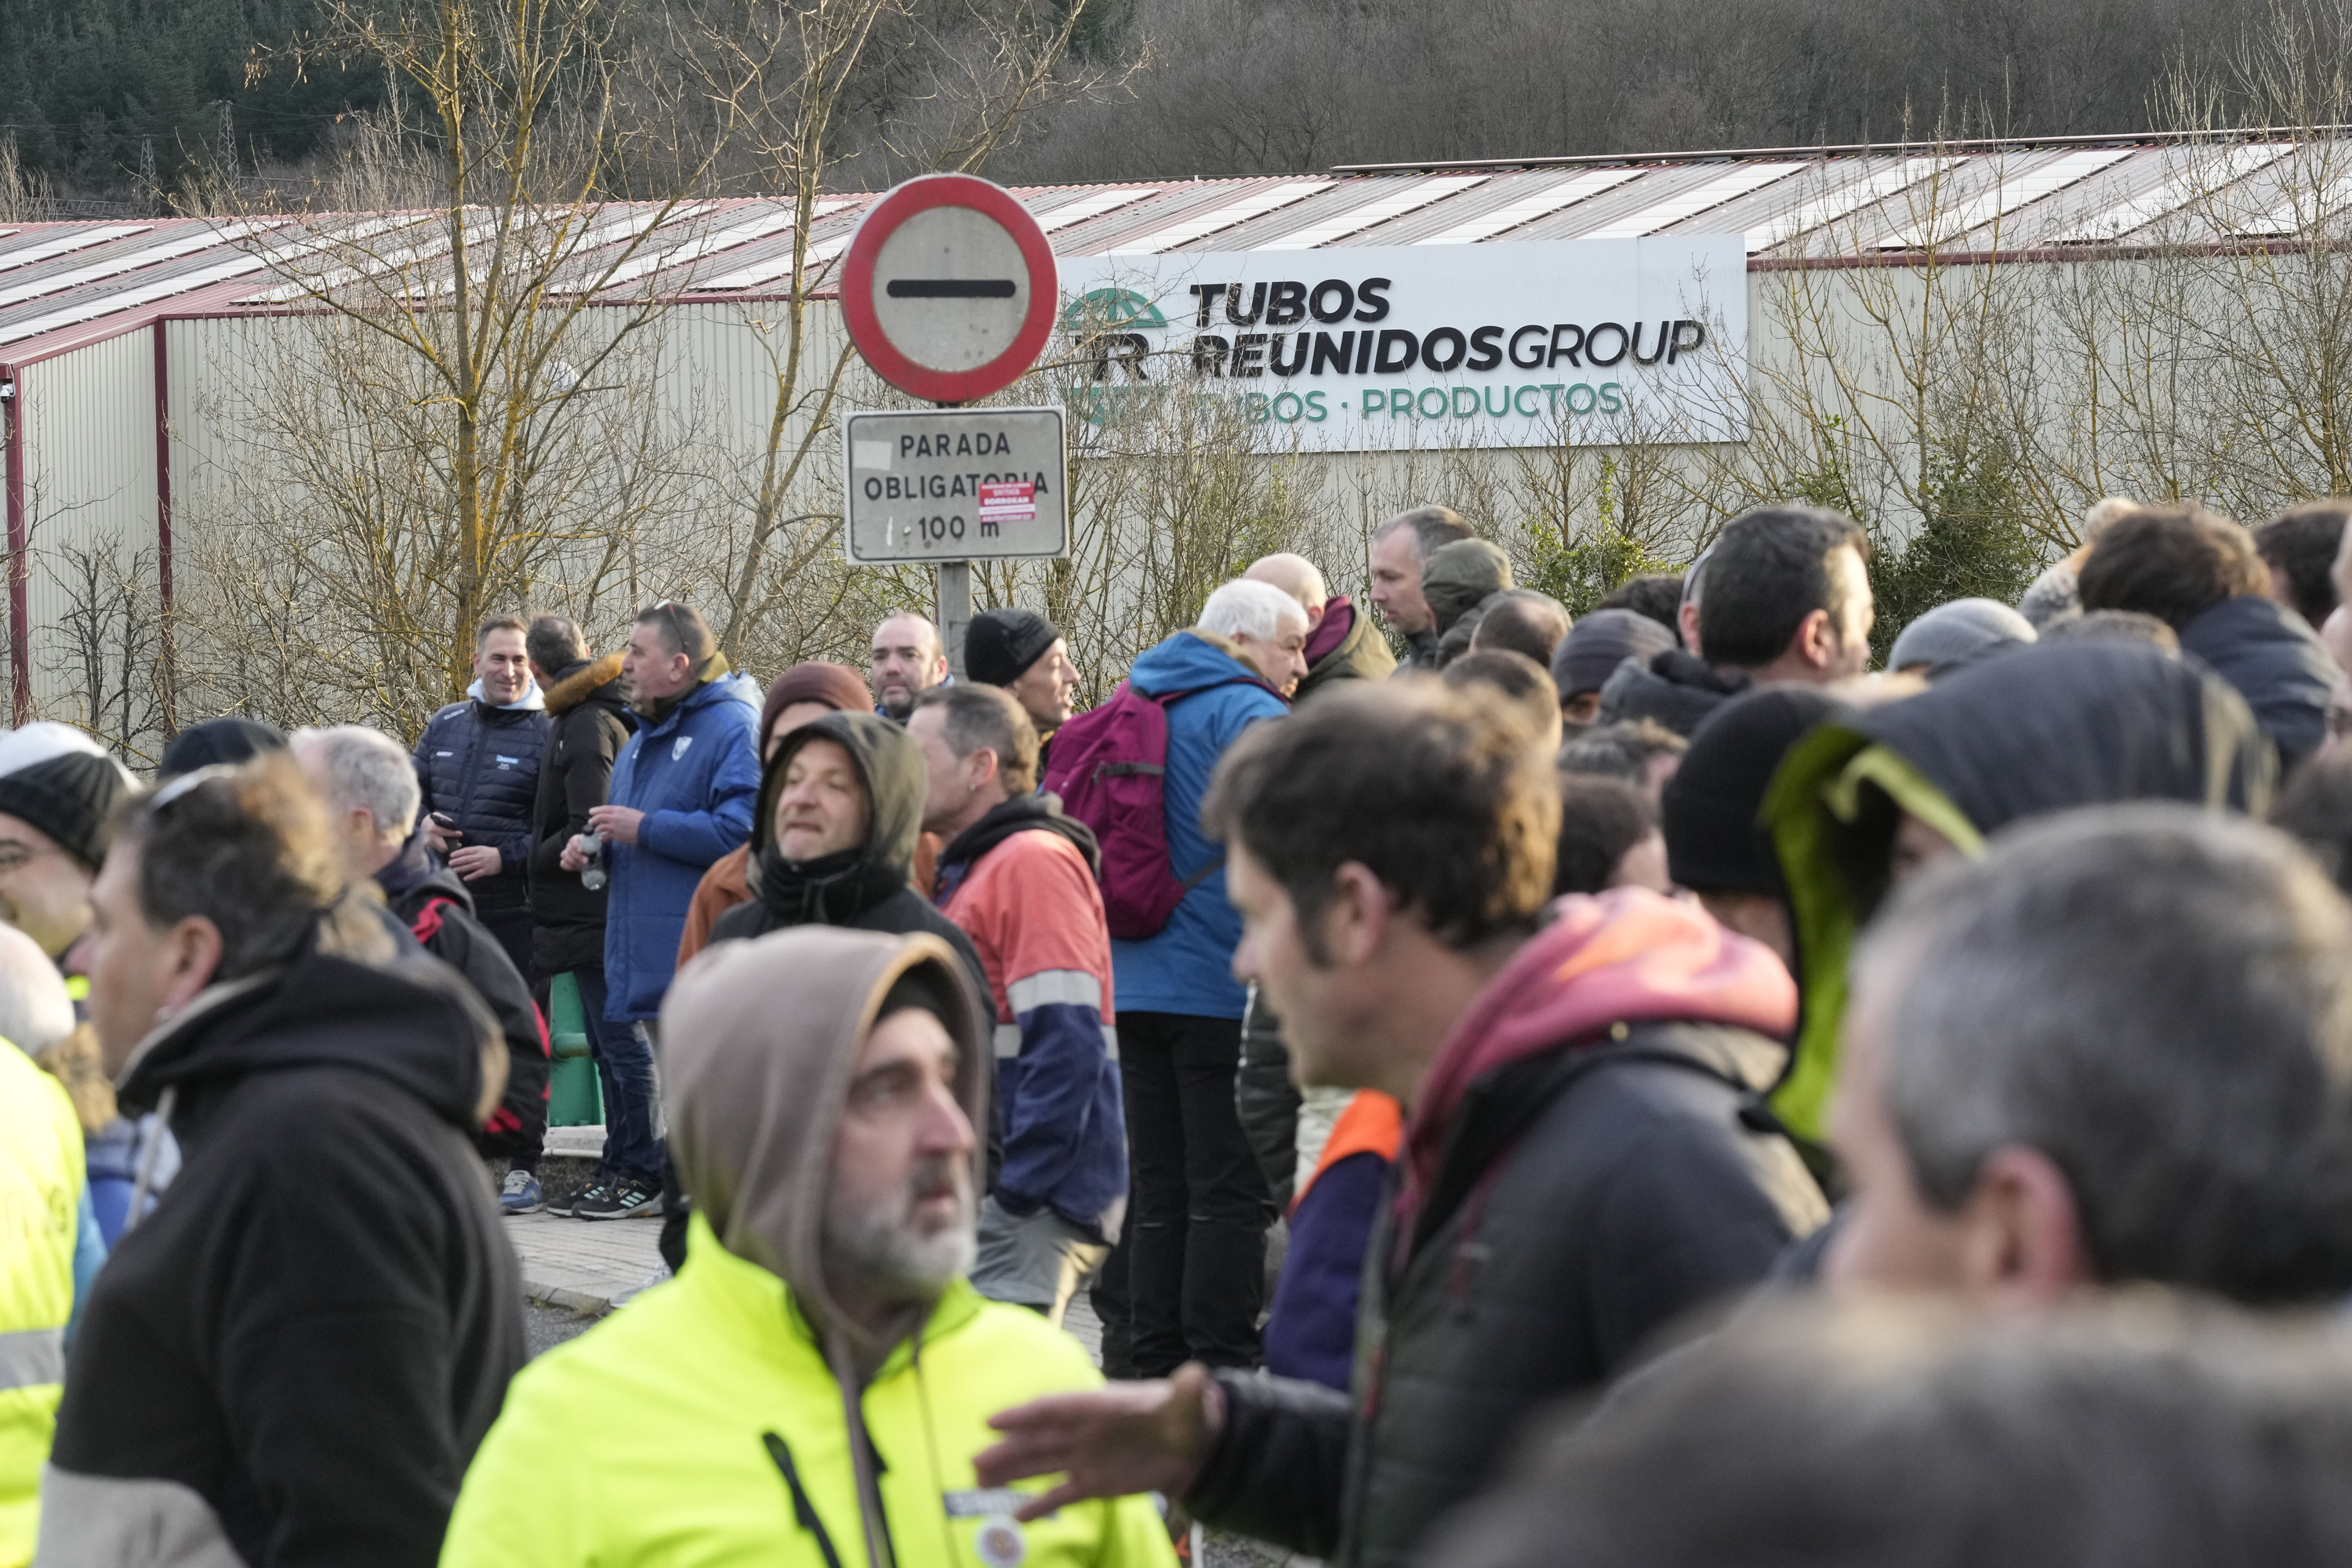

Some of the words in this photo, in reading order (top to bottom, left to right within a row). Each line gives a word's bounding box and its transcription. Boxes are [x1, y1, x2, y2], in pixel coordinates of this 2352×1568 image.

[1189, 278, 1389, 327] TUBOS
[1363, 383, 1622, 420] PRODUCTOS
[901, 433, 1011, 458] PARADA
[919, 516, 965, 539] 100
